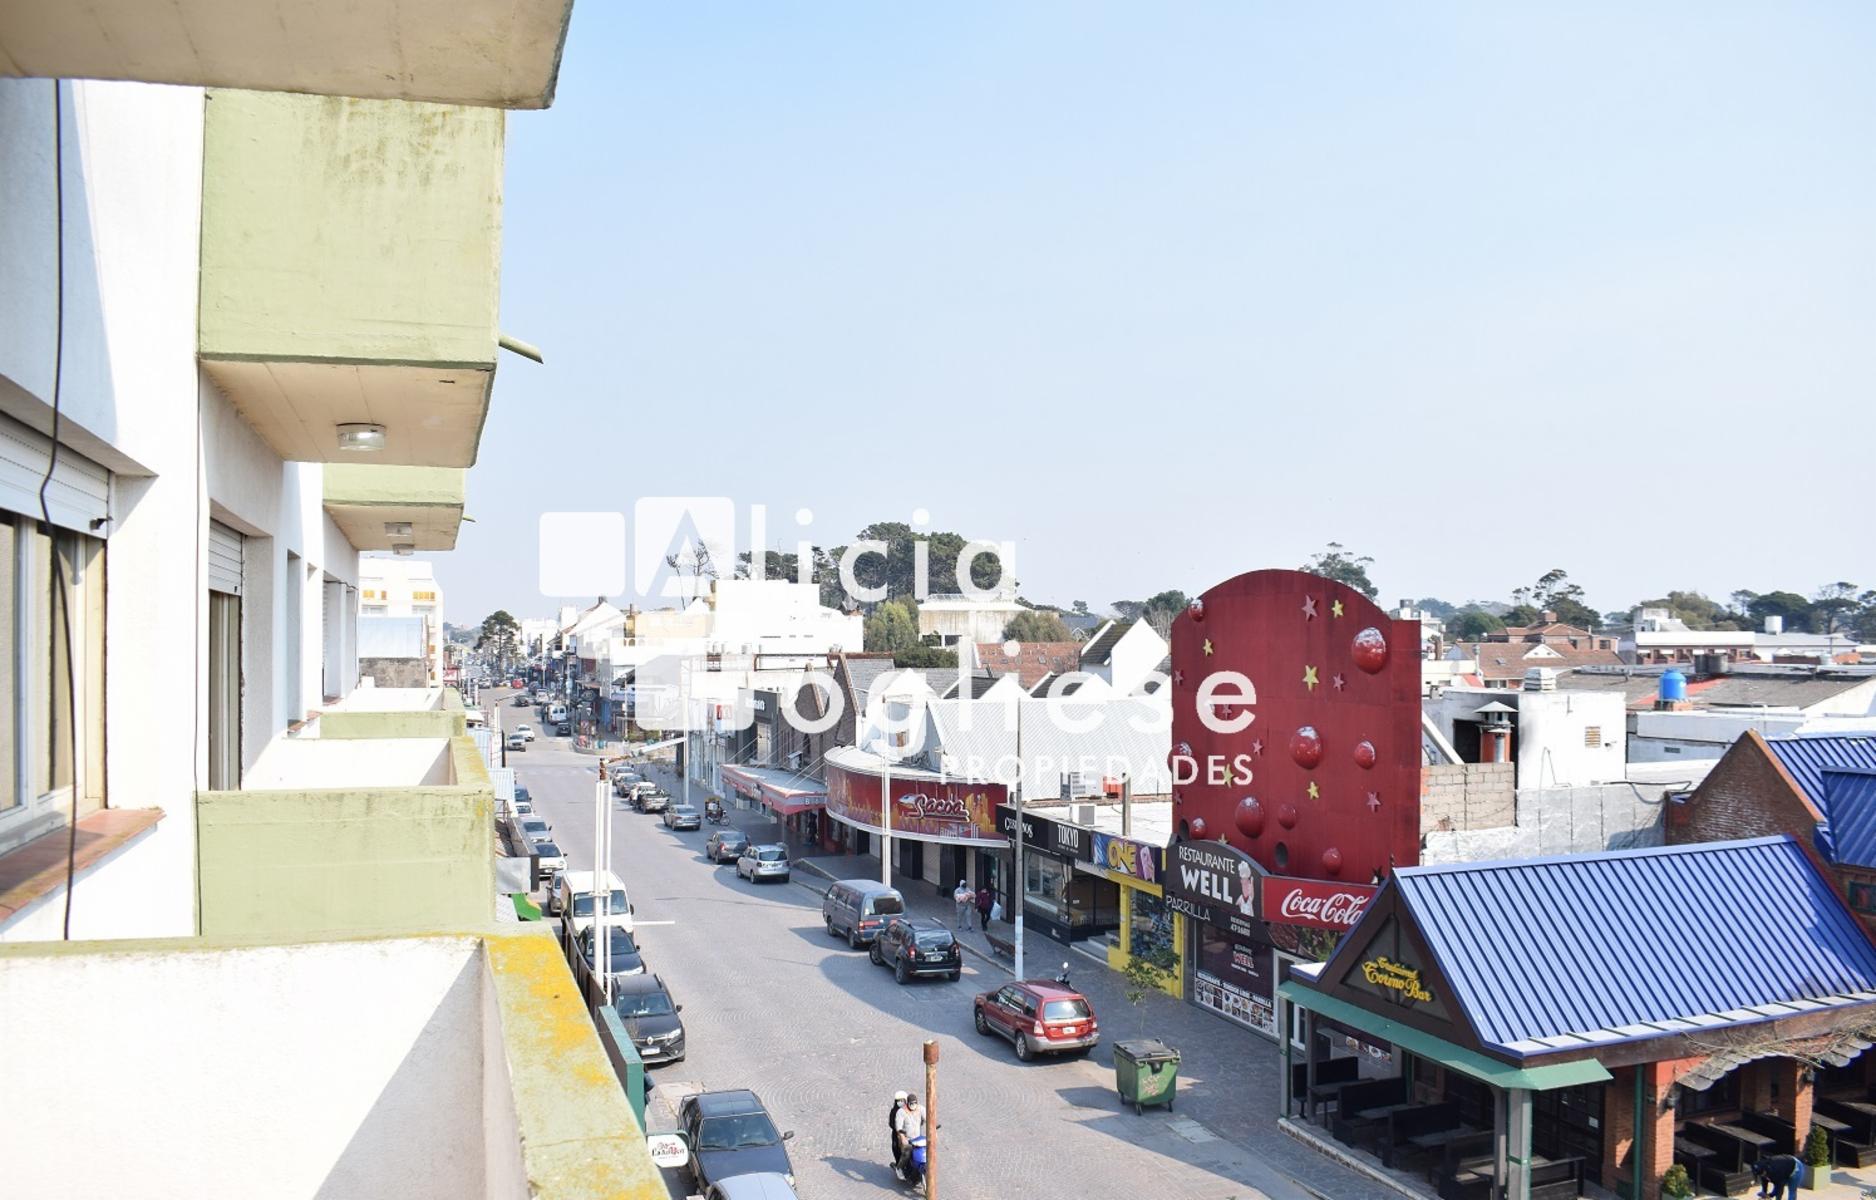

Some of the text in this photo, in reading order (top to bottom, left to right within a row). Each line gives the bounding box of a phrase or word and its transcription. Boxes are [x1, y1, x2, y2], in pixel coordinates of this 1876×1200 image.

[1057, 825, 1079, 848] TOKYO
[1108, 839, 1137, 874] ONE
[1179, 846, 1235, 874] RESTAURANTE
[1181, 864, 1233, 904] WELL
[1166, 895, 1211, 921] PARRILLA
